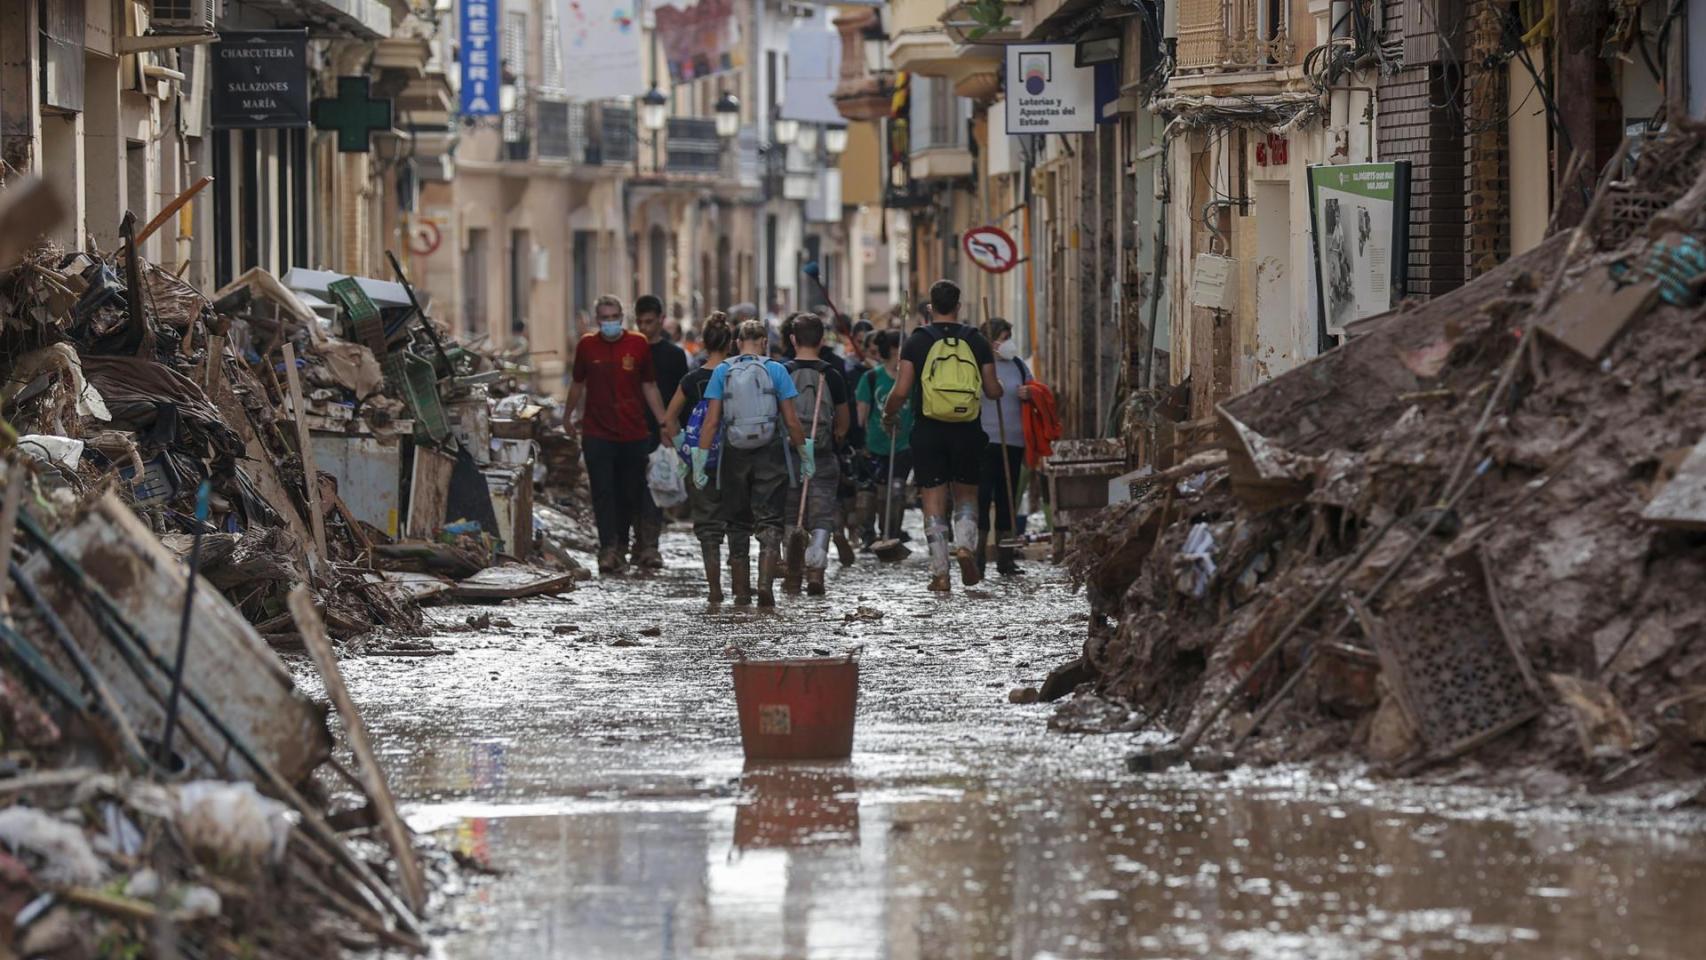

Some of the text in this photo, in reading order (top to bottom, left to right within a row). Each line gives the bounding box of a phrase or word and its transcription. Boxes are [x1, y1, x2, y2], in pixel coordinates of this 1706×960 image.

[221, 46, 295, 58] CHARCUTERÍA
[466, 0, 491, 112] RETERIA
[254, 65, 261, 75] Y
[228, 82, 289, 92] SALAZONES
[243, 97, 277, 109] MARÍA
[1056, 99, 1062, 107] y
[1020, 106, 1076, 117] Apuestas del
[1019, 117, 1049, 126] Estado
